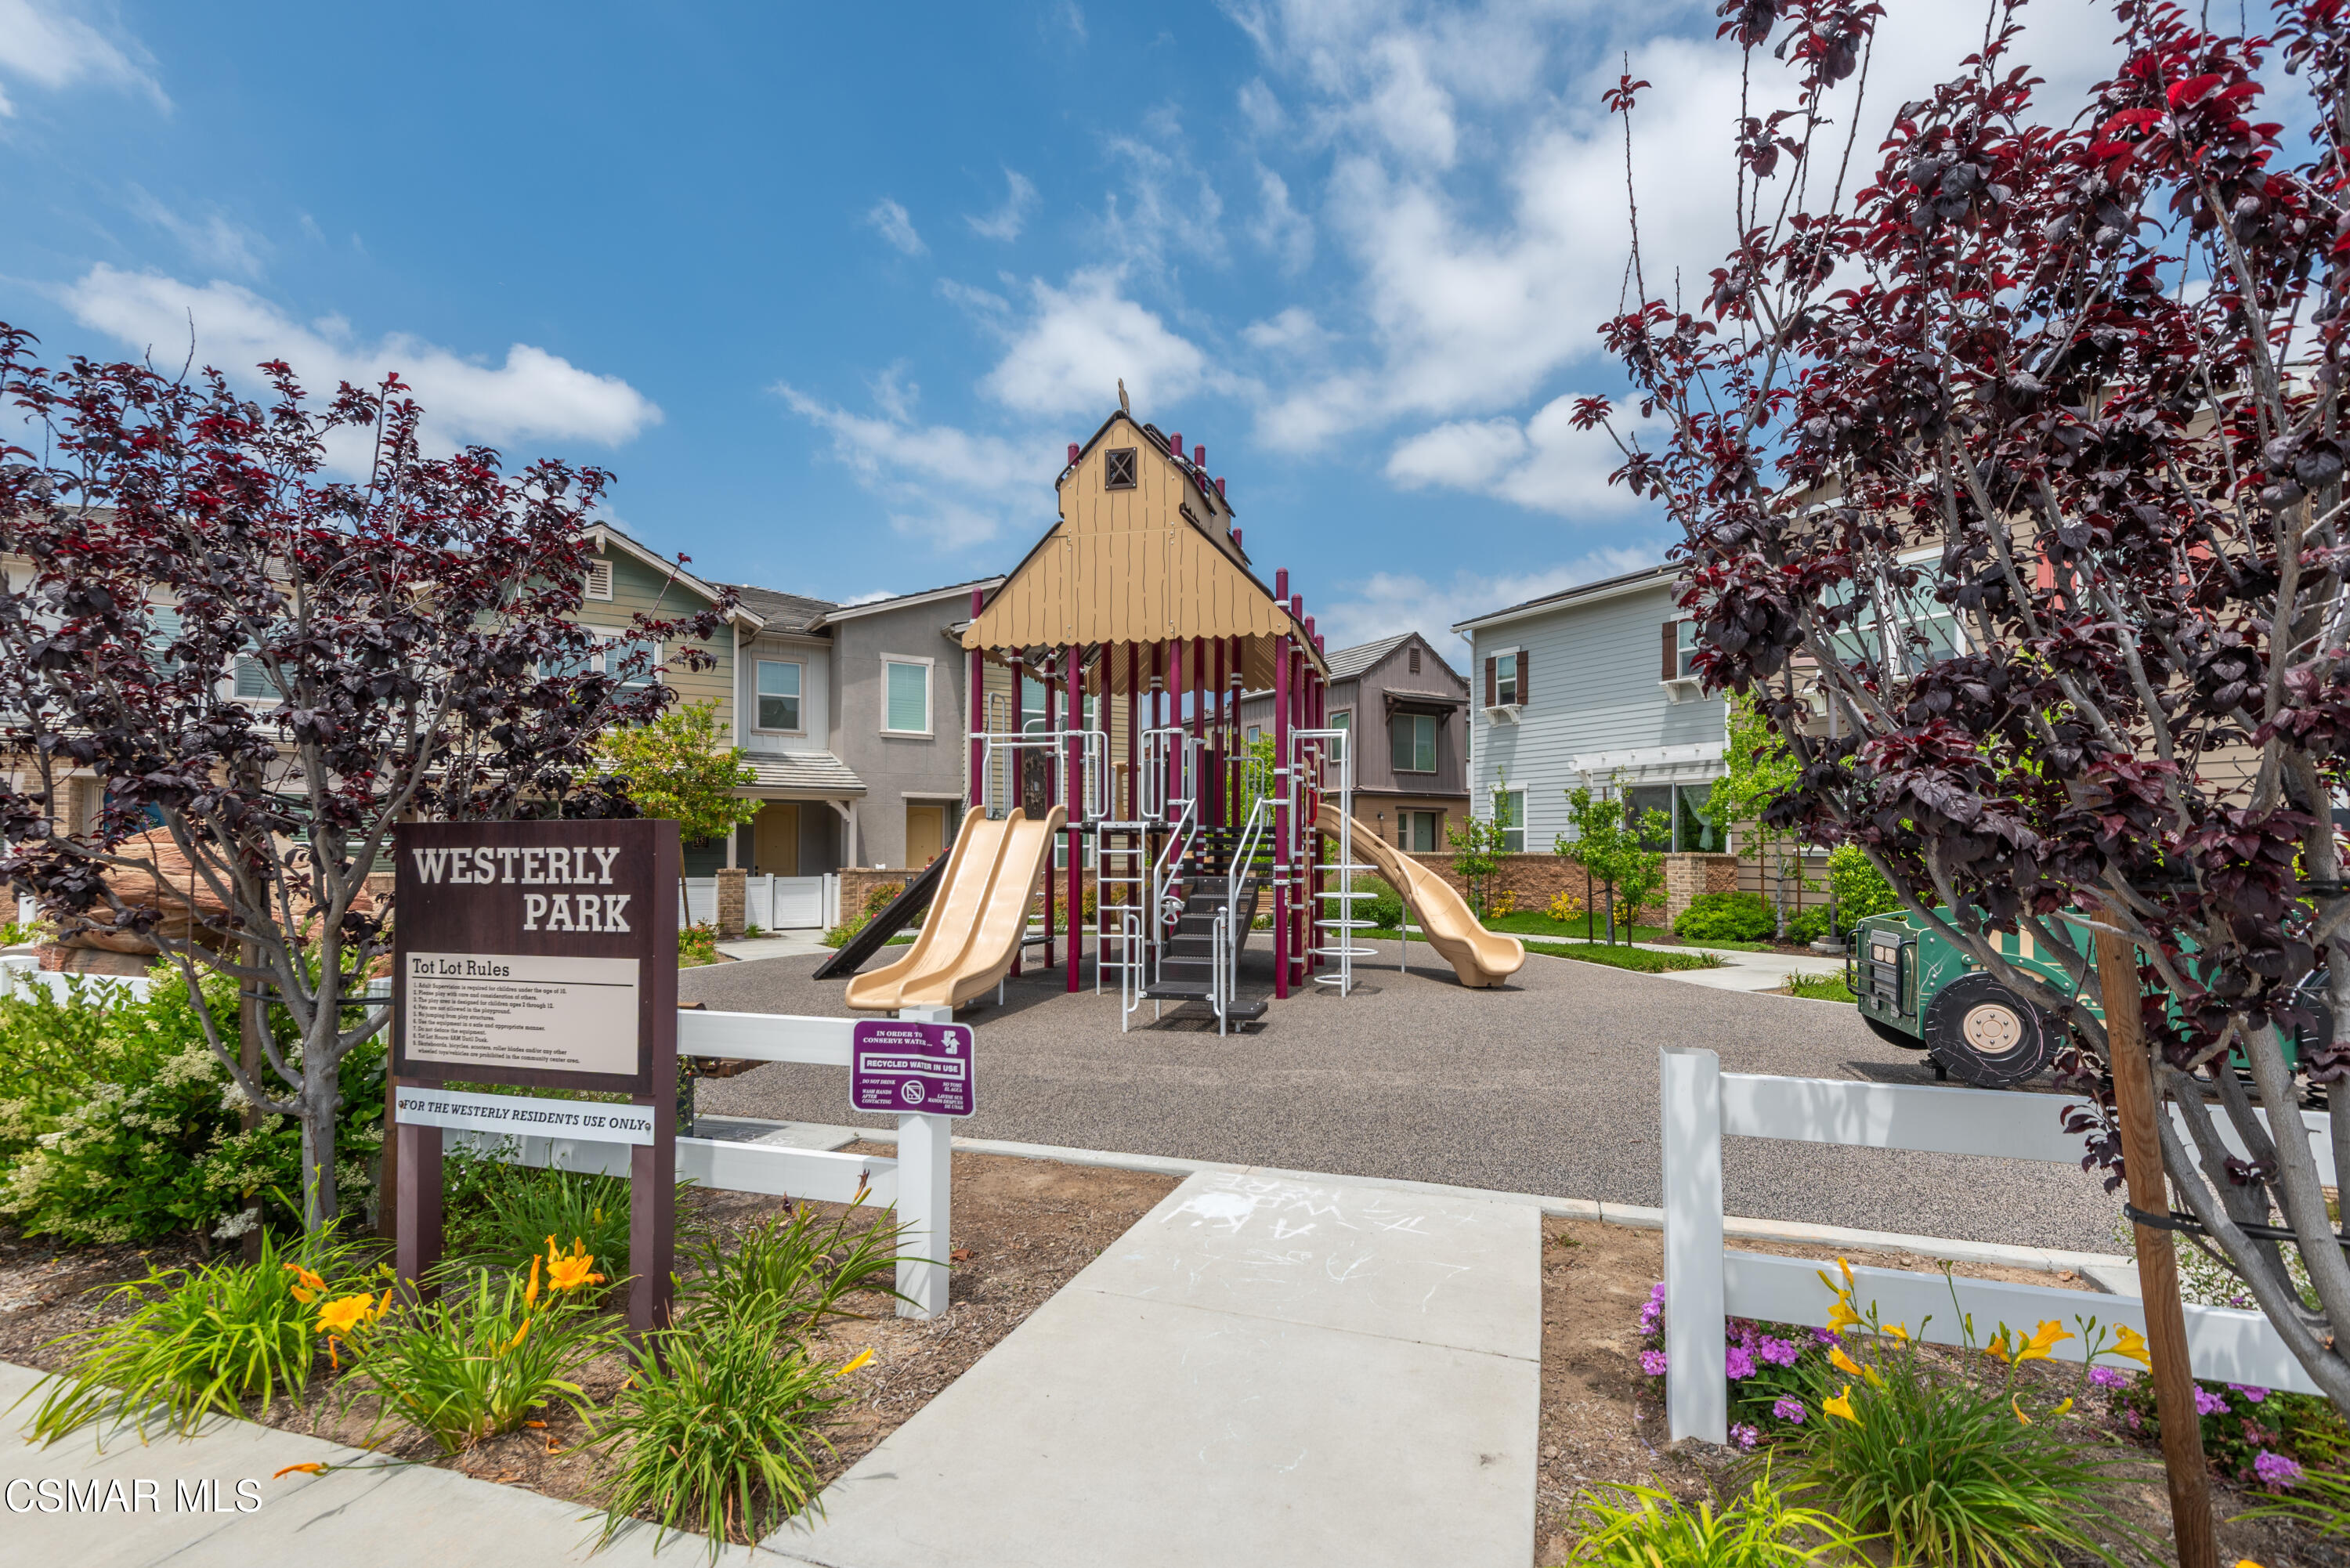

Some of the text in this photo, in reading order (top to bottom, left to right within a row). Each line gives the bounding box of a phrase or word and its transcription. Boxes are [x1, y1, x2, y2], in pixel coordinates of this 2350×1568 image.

[413, 847, 620, 884] WESTERLY
[523, 894, 631, 932] PARK
[413, 958, 510, 977] Tot Lot Rules
[909, 1060, 932, 1070] WATER
[403, 1100, 646, 1130] FOR THE WESTERLY RESIDENTS USE ONLY
